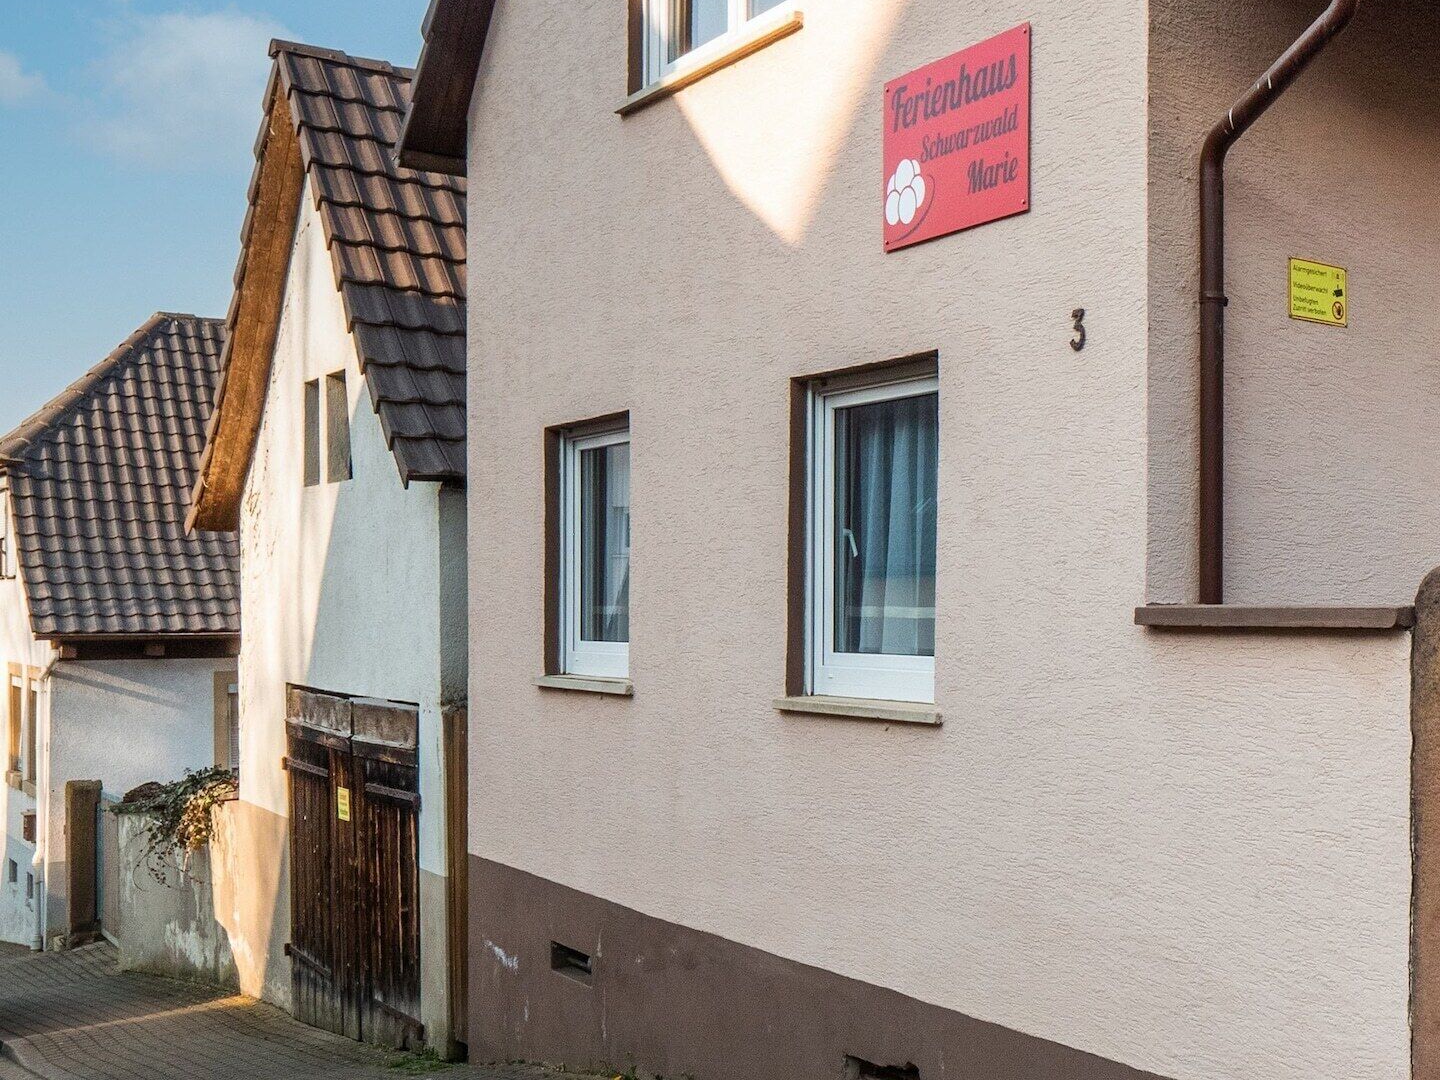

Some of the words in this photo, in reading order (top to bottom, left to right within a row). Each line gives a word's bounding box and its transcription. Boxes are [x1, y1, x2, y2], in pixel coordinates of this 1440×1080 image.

[891, 52, 1018, 133] Ferienhaus
[920, 104, 1018, 163] Schwarzwald
[967, 151, 1018, 195] Marie
[1070, 308, 1086, 352] 3
